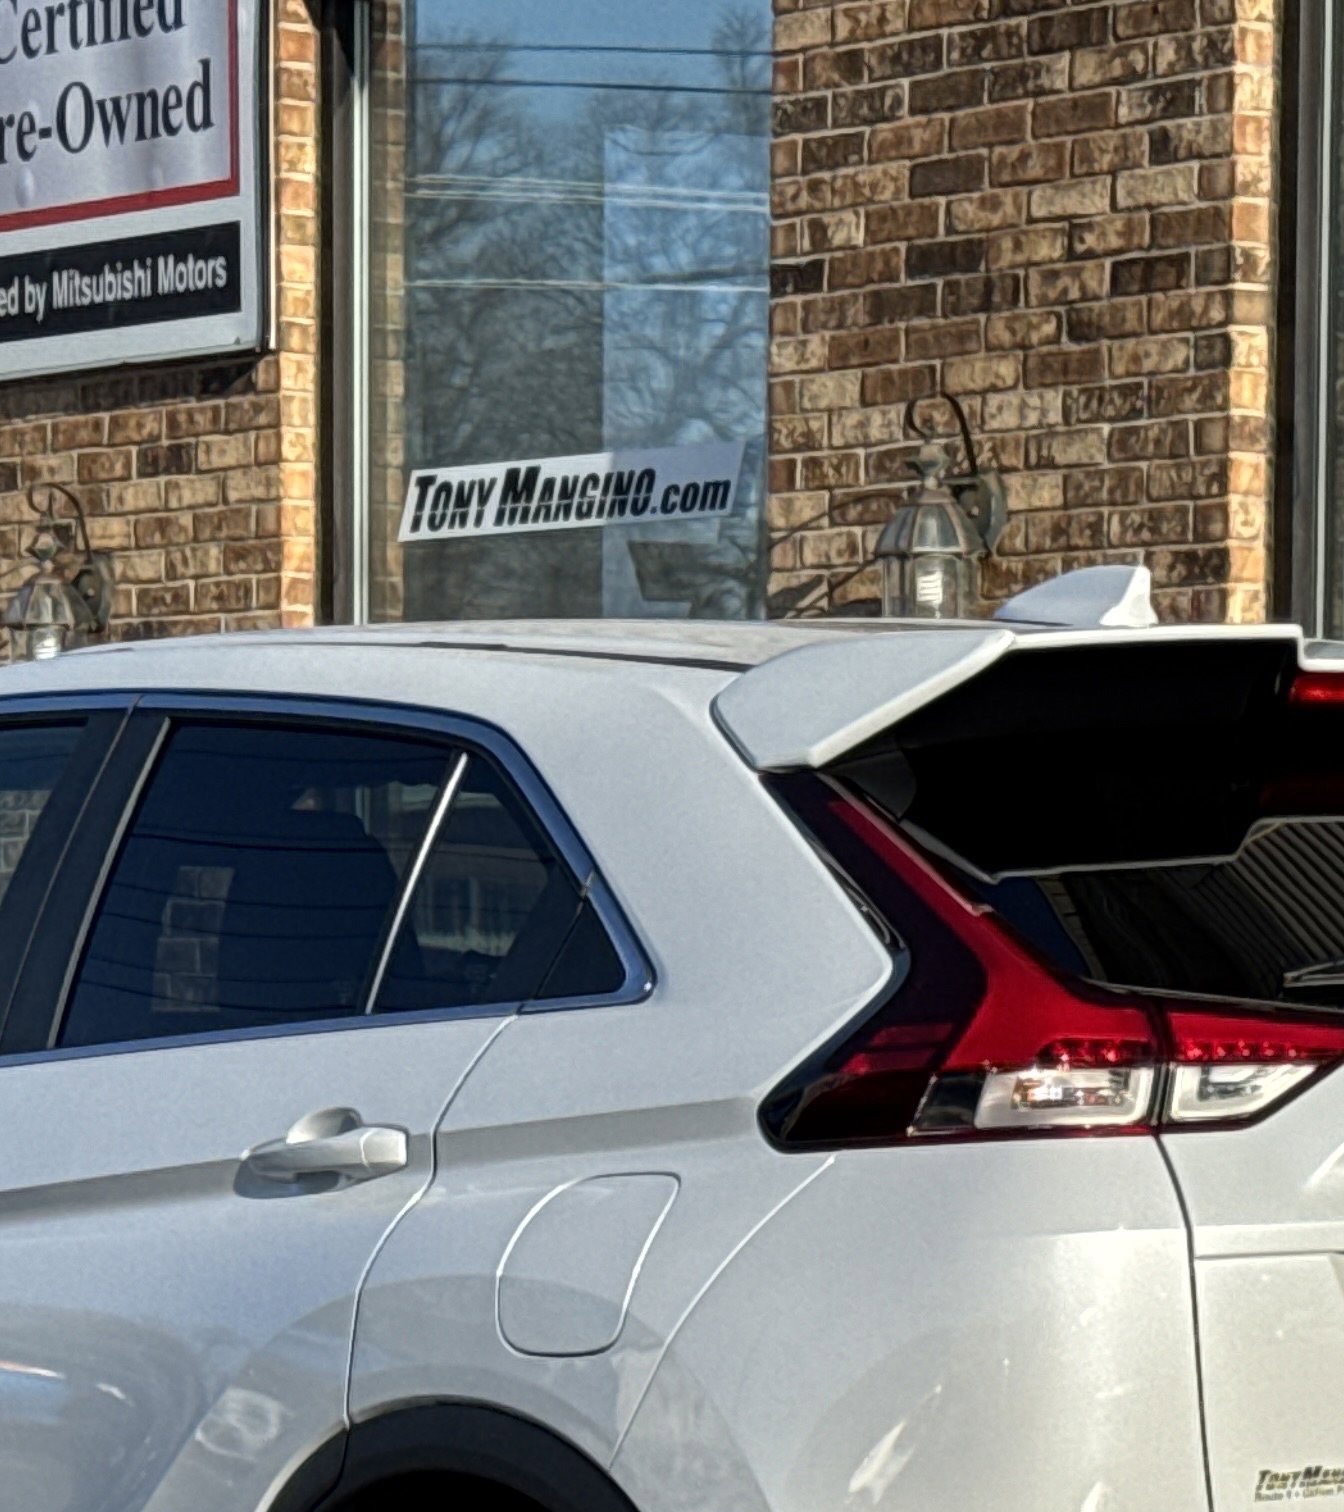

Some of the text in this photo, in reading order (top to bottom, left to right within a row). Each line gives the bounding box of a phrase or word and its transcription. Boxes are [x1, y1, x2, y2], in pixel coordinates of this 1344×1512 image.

[24, 275, 47, 323] by
[52, 256, 152, 309] Mitsubishi
[157, 253, 227, 295] Motors
